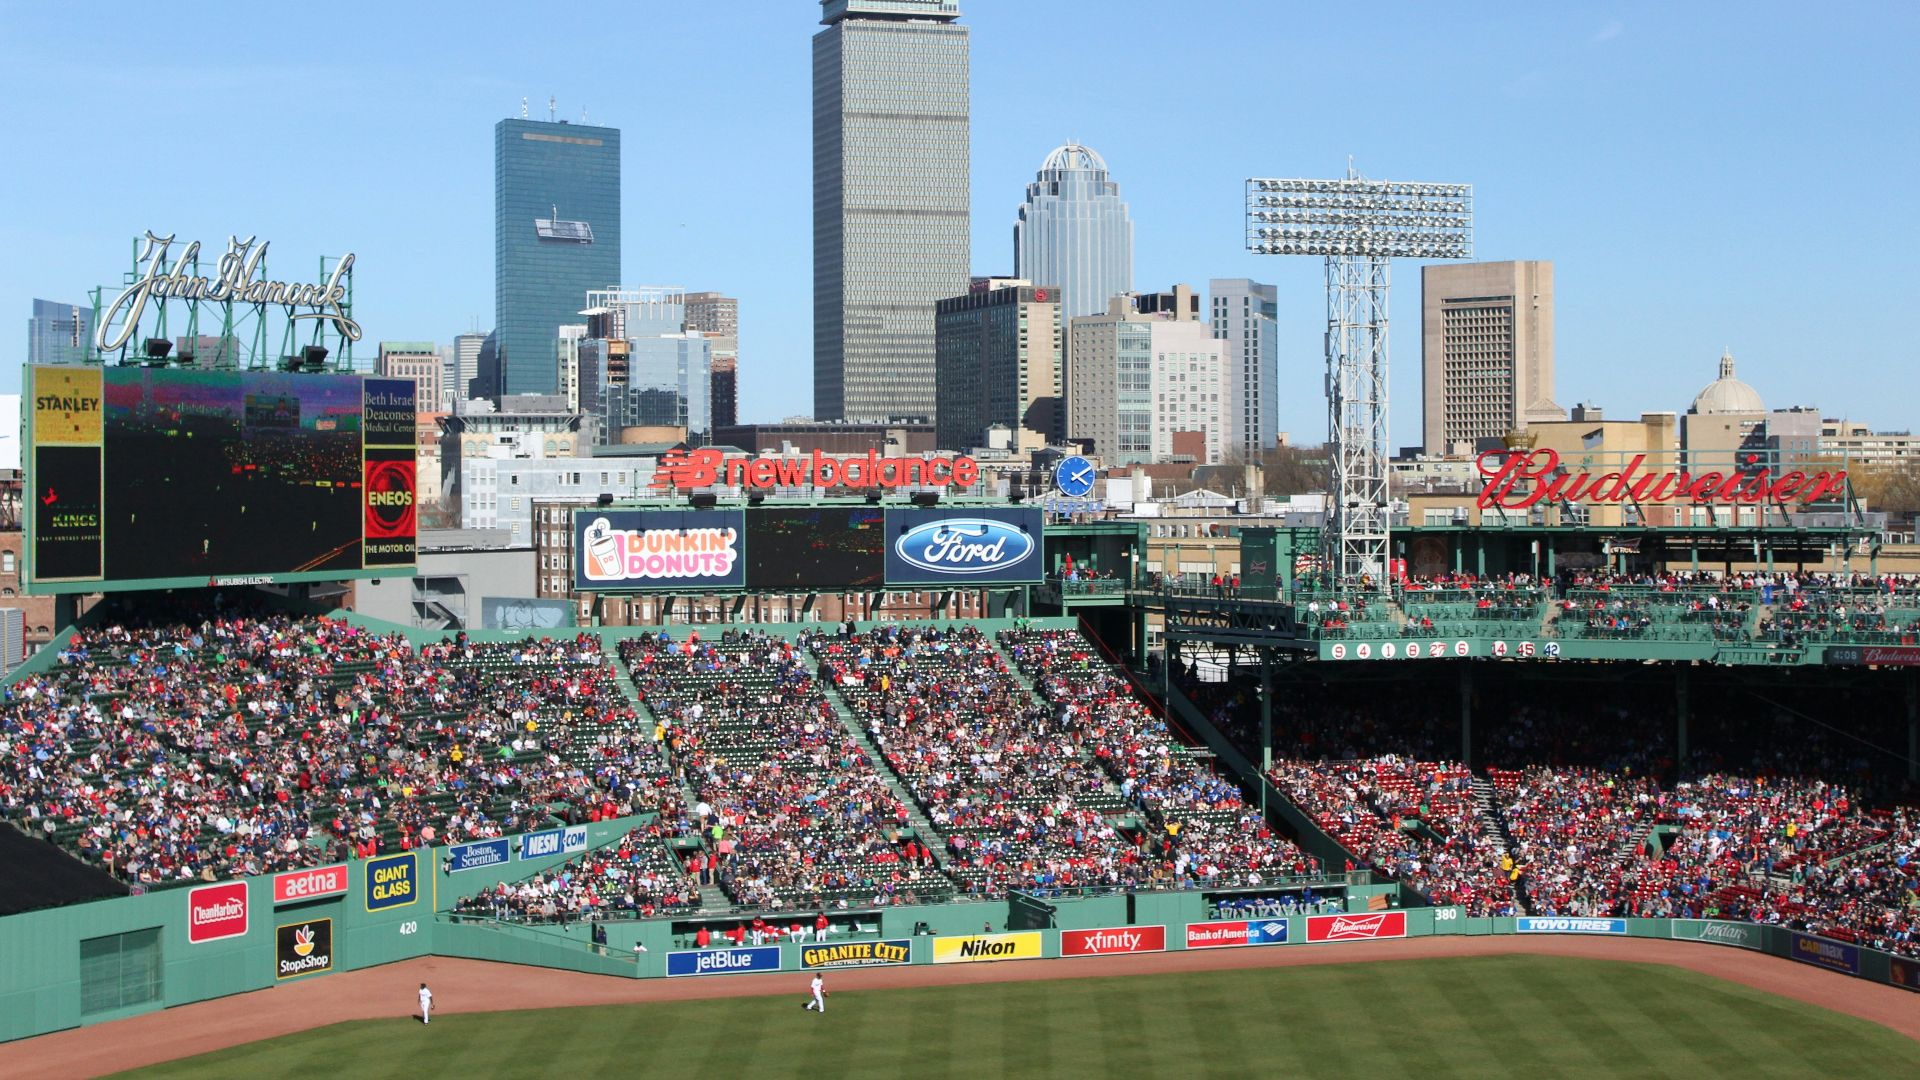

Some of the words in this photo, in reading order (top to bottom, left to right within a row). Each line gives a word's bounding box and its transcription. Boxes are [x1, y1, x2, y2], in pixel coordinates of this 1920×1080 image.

[97, 230, 208, 351] John
[208, 235, 361, 341] Hancock
[37, 396, 98, 411] STANLEY
[365, 392, 386, 405] Beth
[390, 393, 415, 406] Israel
[365, 407, 415, 420] Deaconess
[365, 422, 391, 432] Medical
[393, 422, 415, 432] Center
[727, 458, 809, 488] new
[813, 448, 978, 487] balance
[1476, 448, 1848, 509] Budweiser
[368, 491, 412, 506] ENEOS
[52, 514, 97, 527] KINGS
[366, 544, 377, 554] THE
[379, 543, 403, 553] MOTOR
[405, 543, 415, 552] OIL
[628, 532, 733, 553] DUNKIN'
[924, 526, 1007, 562] Ford
[628, 553, 728, 574] DONUTS
[217, 577, 247, 586] MITSUBISHI
[249, 576, 273, 585] ELECTRIC
[1429, 643, 1447, 657] 27
[1492, 642, 1505, 655] 14
[1517, 643, 1534, 656] 45
[1543, 644, 1558, 656] 42
[467, 846, 492, 857] Boston
[528, 833, 559, 856] NESN
[461, 850, 501, 867] Scientific
[374, 864, 408, 883] GIANT
[286, 872, 337, 897] aetna
[373, 880, 410, 900] GLASS
[1435, 909, 1456, 921] 380
[400, 921, 417, 935] 420
[1331, 921, 1379, 932] Budweiser
[1528, 919, 1569, 930] TOYO
[1570, 920, 1611, 931] TIRES
[1699, 922, 1748, 939] Jordan's
[1084, 931, 1141, 953] xfinity
[1189, 931, 1211, 941] Bank
[1212, 929, 1222, 939] of
[1222, 928, 1259, 939] America
[804, 944, 871, 965] GRANITE
[874, 943, 908, 960] CITY
[960, 940, 1015, 957] Nikon
[695, 951, 751, 973] jetBlue
